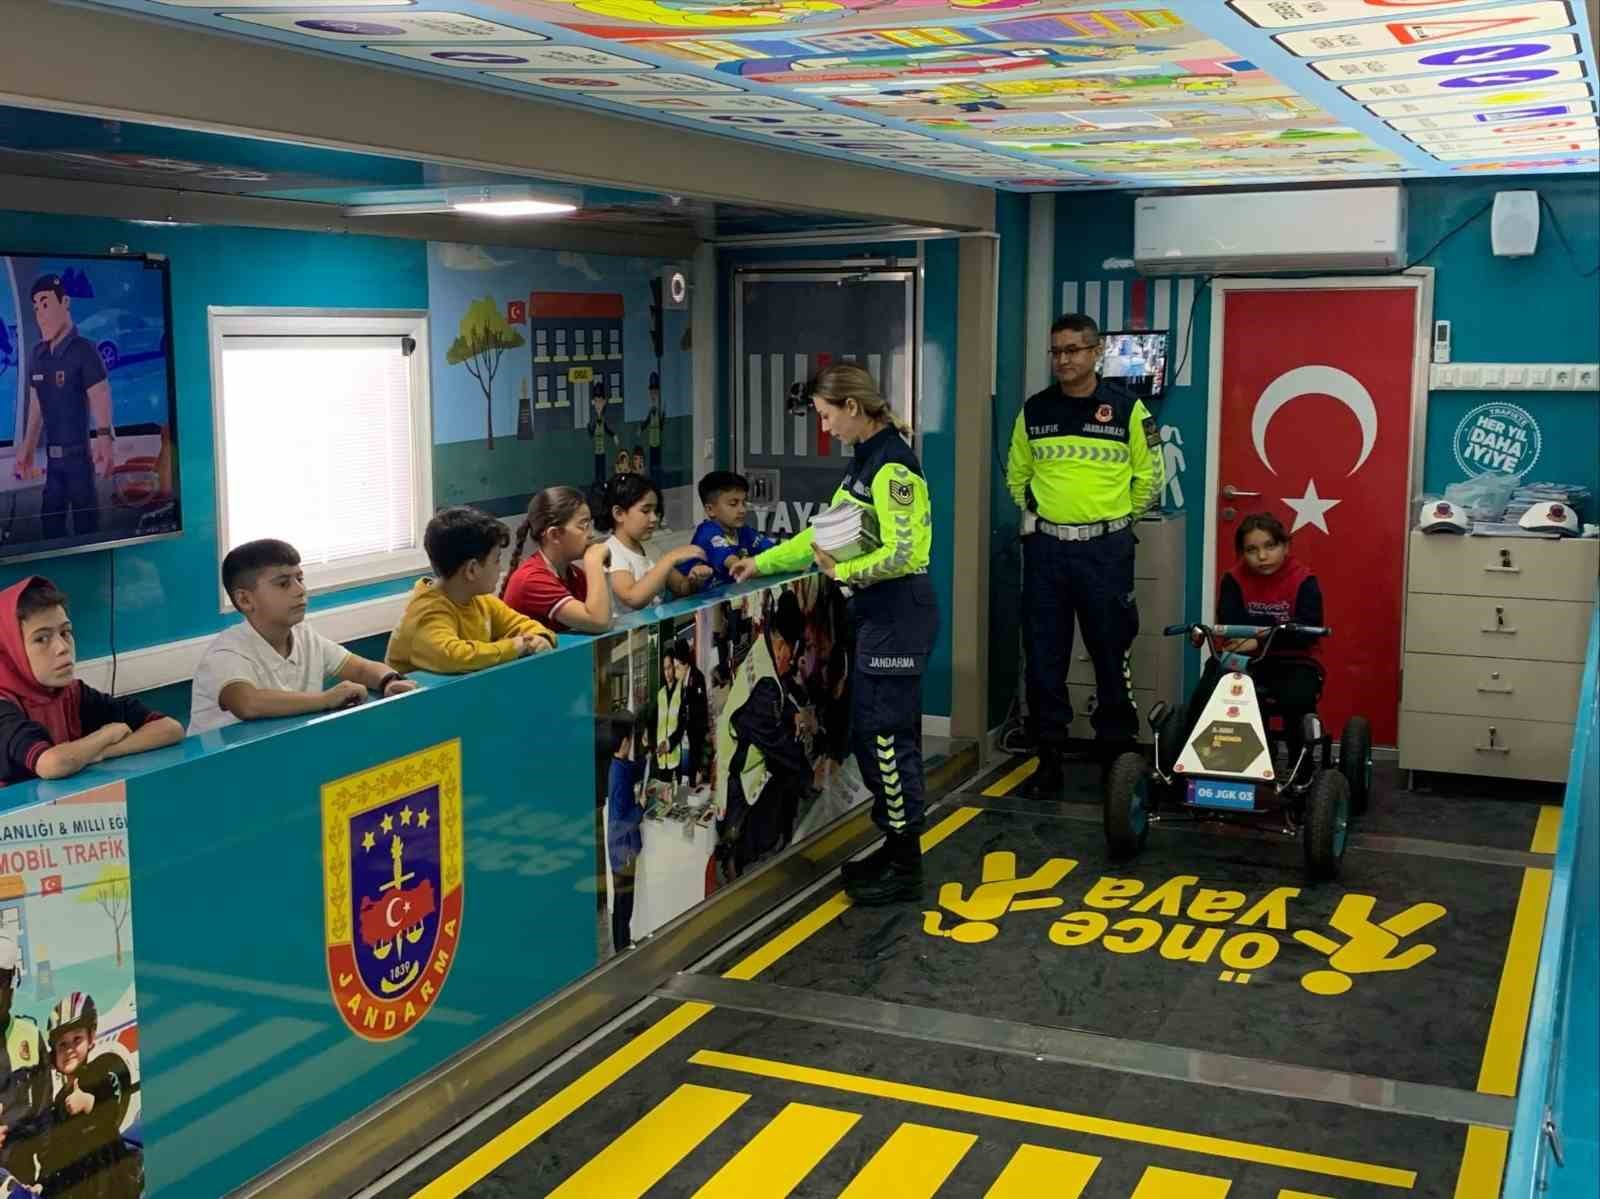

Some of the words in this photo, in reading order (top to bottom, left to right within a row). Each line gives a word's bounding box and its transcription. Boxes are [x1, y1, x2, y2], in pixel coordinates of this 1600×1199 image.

[1470, 427, 1521, 459] DAHA
[1477, 415, 1506, 434] HER
[1508, 425, 1528, 442] YIL
[754, 501, 829, 533] YAY
[869, 656, 916, 669] JANDARMA
[1198, 787, 1214, 799] 06
[60, 822, 68, 835] &
[0, 844, 58, 875] MOBİL
[63, 836, 127, 866] TRAFİK
[1083, 875, 1301, 930] yaya
[1048, 911, 1280, 984] önce
[338, 917, 457, 1031] JANDARMA
